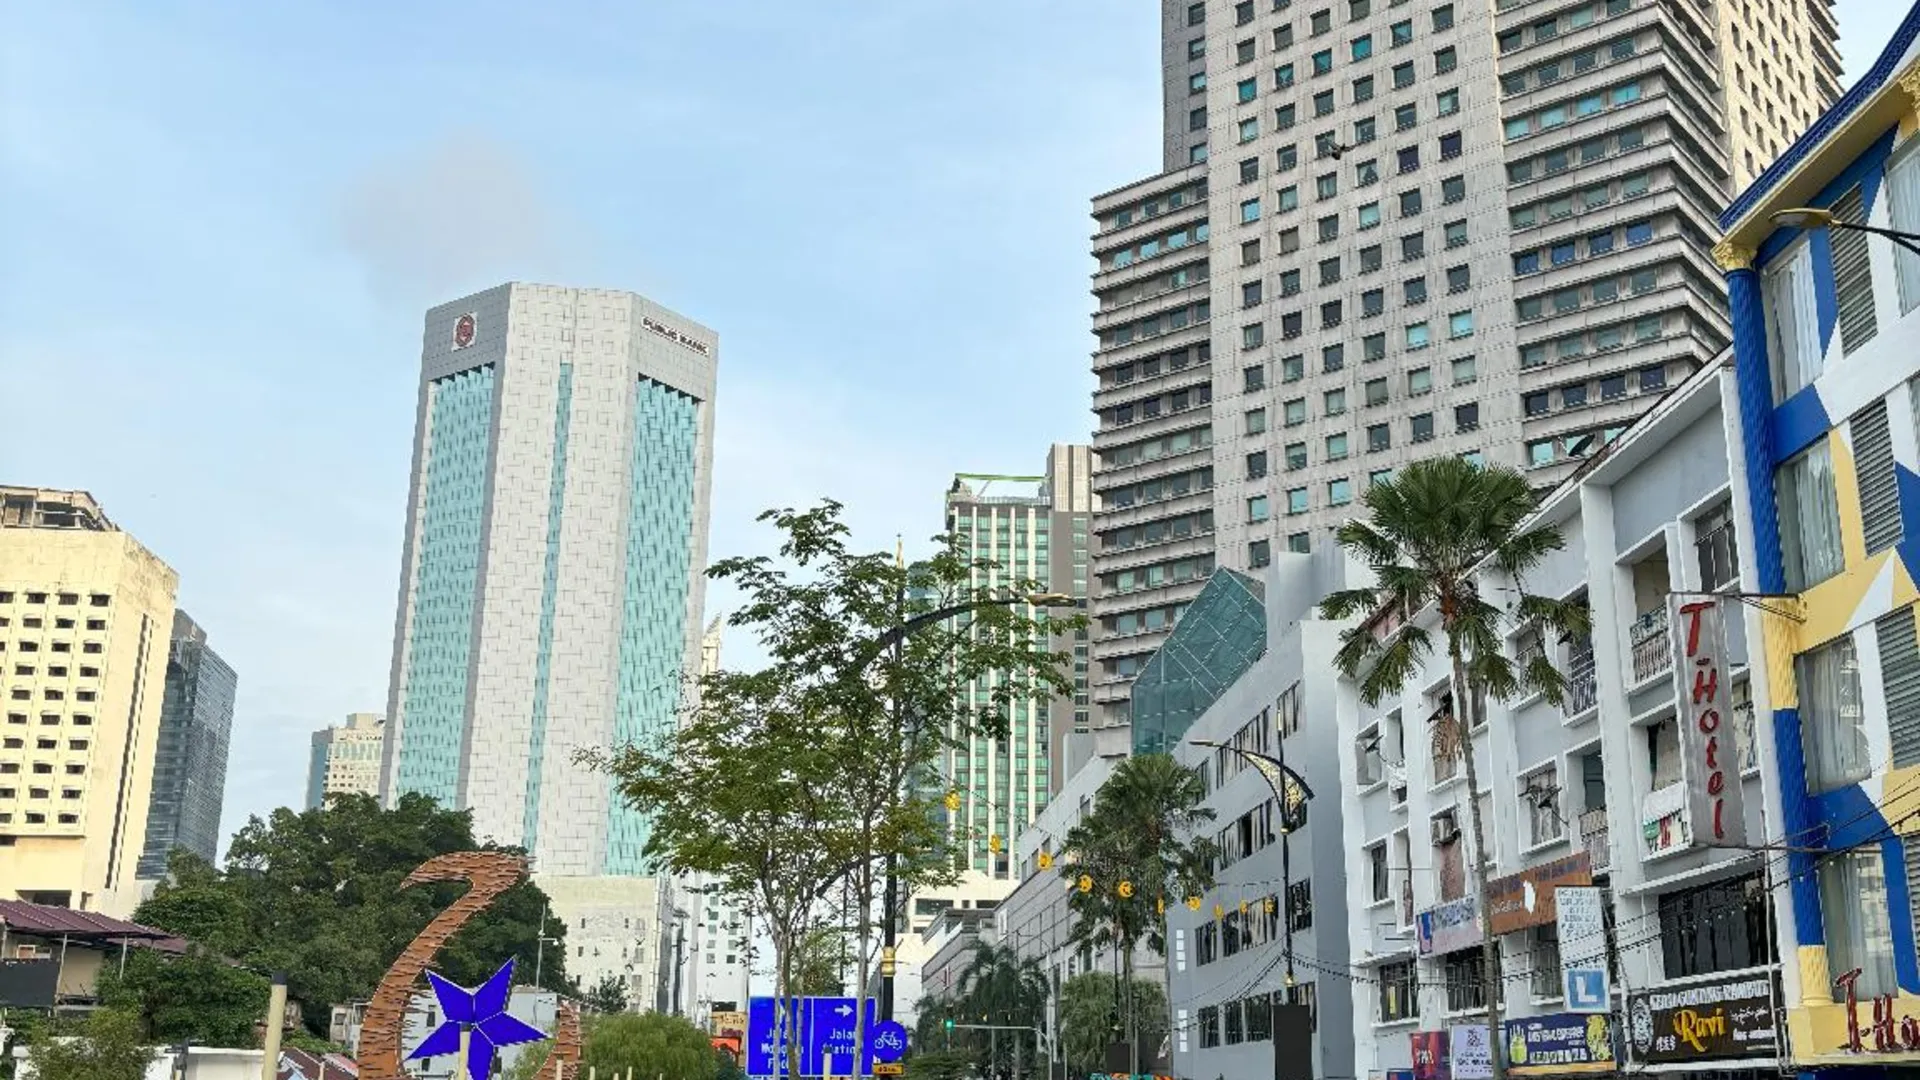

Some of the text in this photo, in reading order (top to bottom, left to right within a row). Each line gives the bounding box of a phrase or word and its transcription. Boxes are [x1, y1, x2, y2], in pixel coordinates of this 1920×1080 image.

[643, 317, 707, 354] PUBLIC BANK
[1680, 601, 1725, 839] T-Hotel
[766, 1027, 795, 1039] Jla
[1673, 1008, 1725, 1052] Ravi
